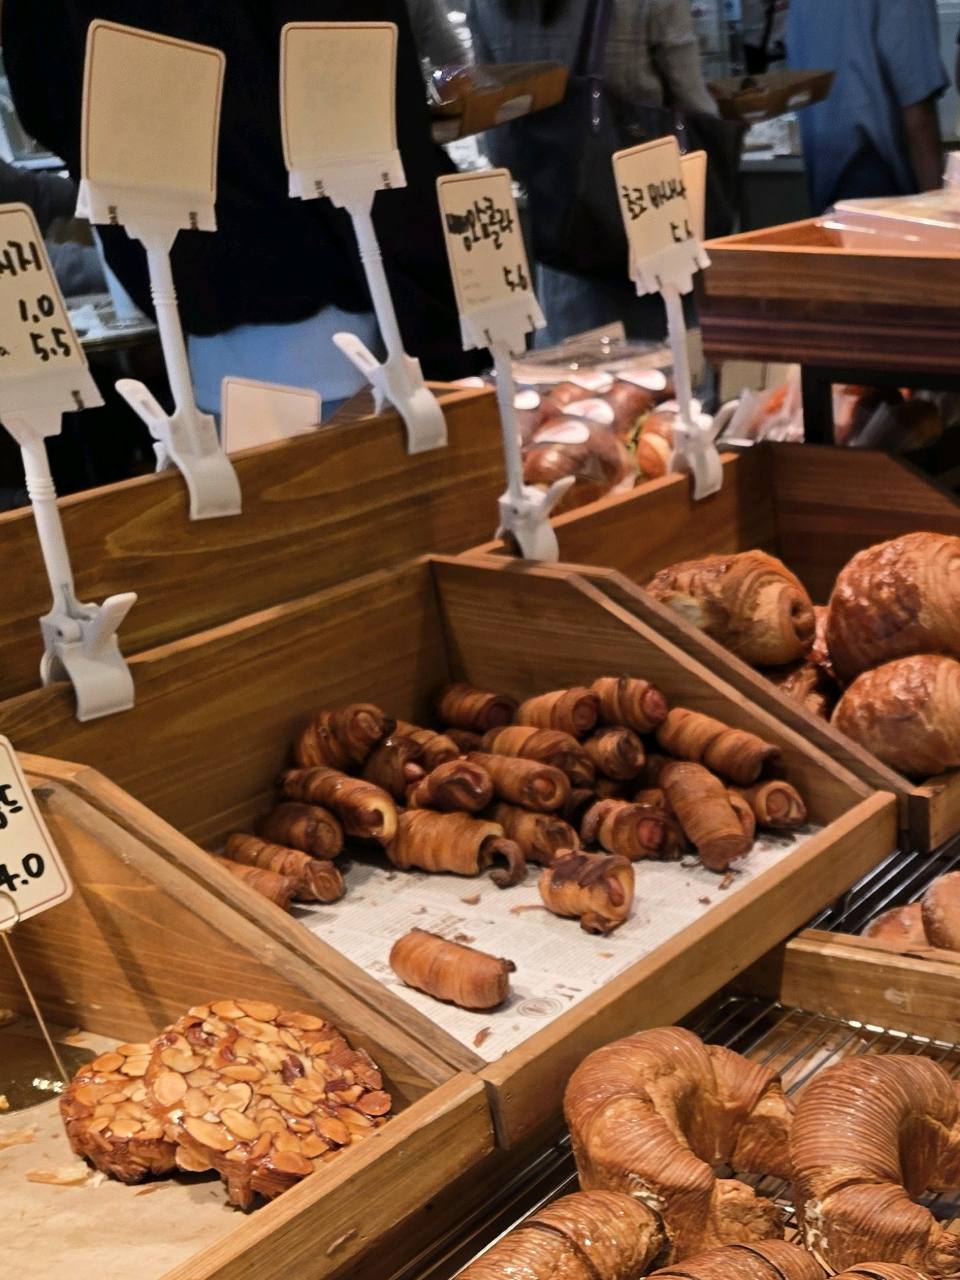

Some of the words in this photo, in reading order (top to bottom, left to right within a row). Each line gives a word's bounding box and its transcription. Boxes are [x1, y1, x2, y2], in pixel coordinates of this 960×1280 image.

[18, 294, 55, 323] 1.0
[29, 326, 71, 362] 5.5
[0, 852, 46, 892] 4.0
